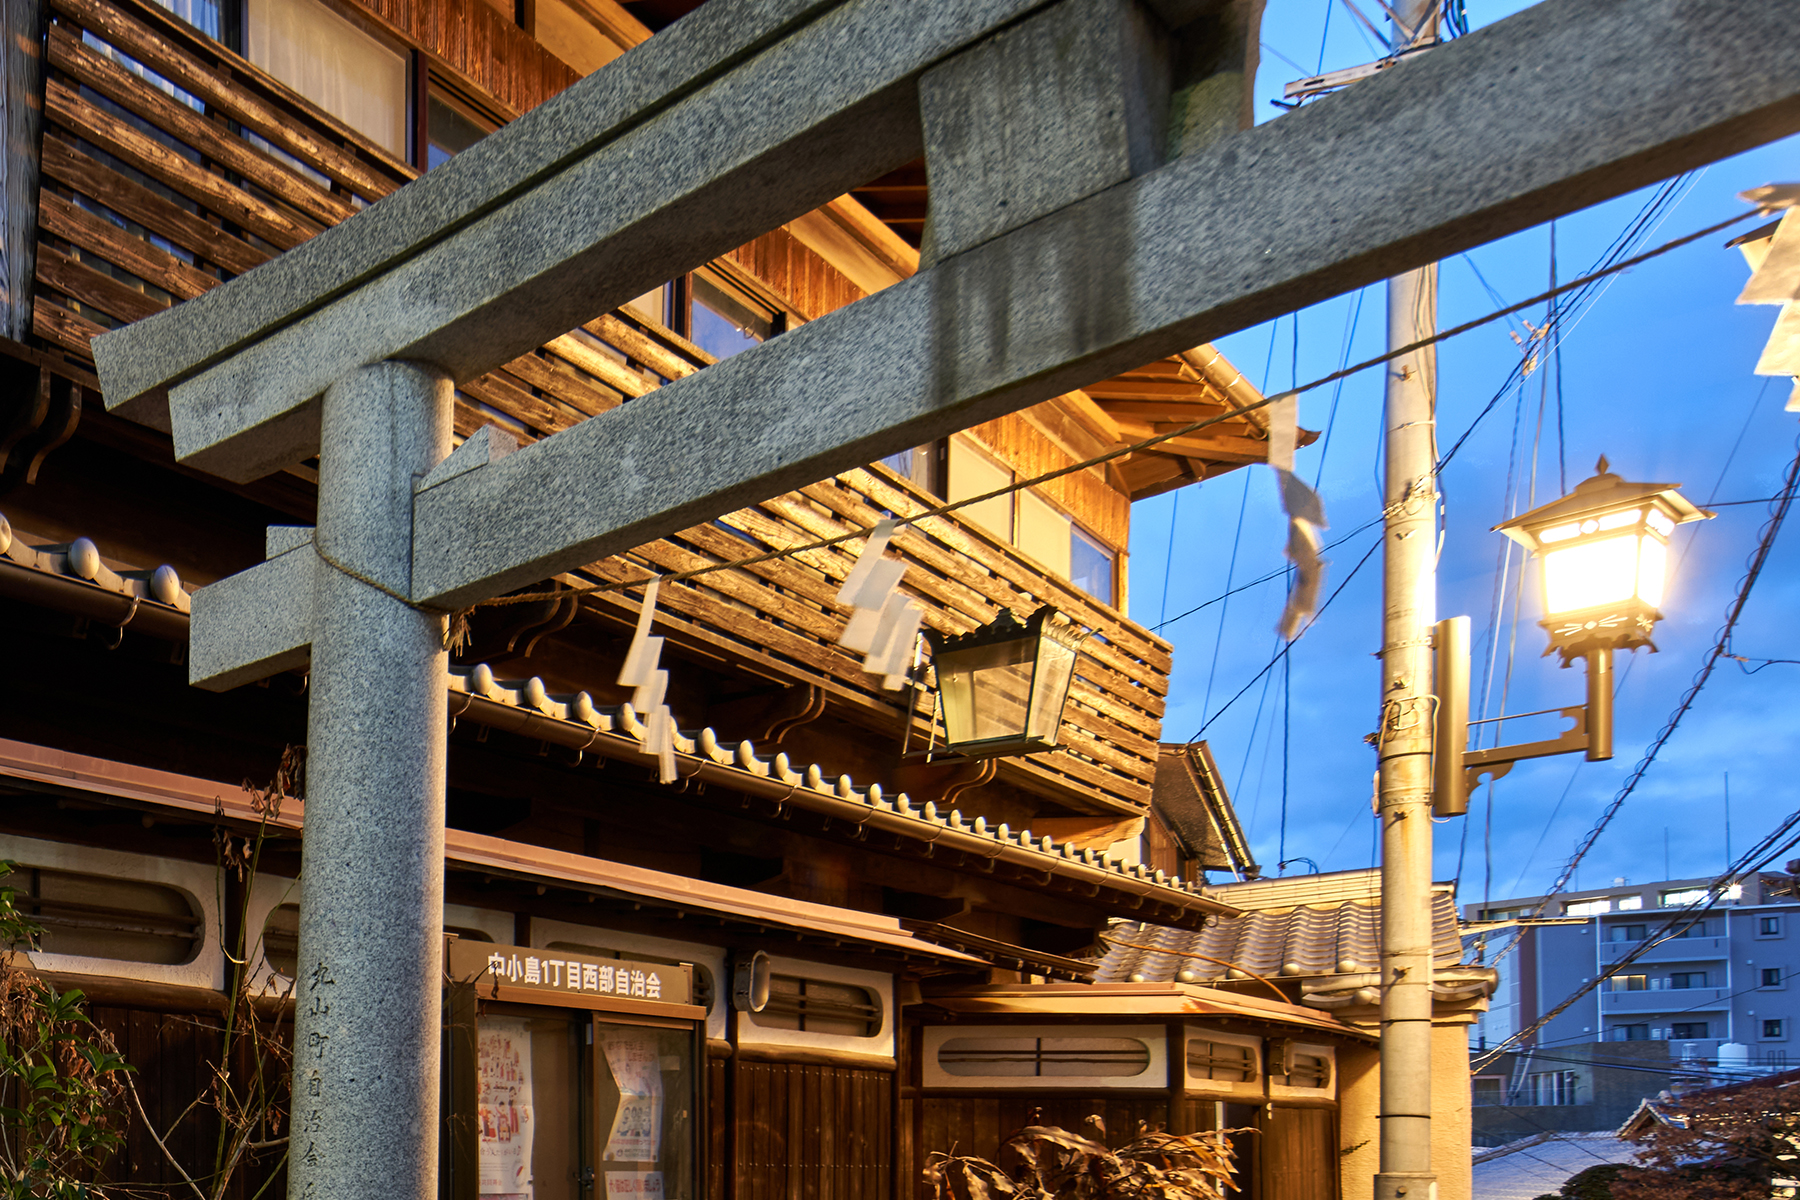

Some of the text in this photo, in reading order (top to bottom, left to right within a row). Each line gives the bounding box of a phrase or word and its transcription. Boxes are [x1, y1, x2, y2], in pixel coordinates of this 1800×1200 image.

[488, 952, 661, 999] 中小島1丁目西部自治会
